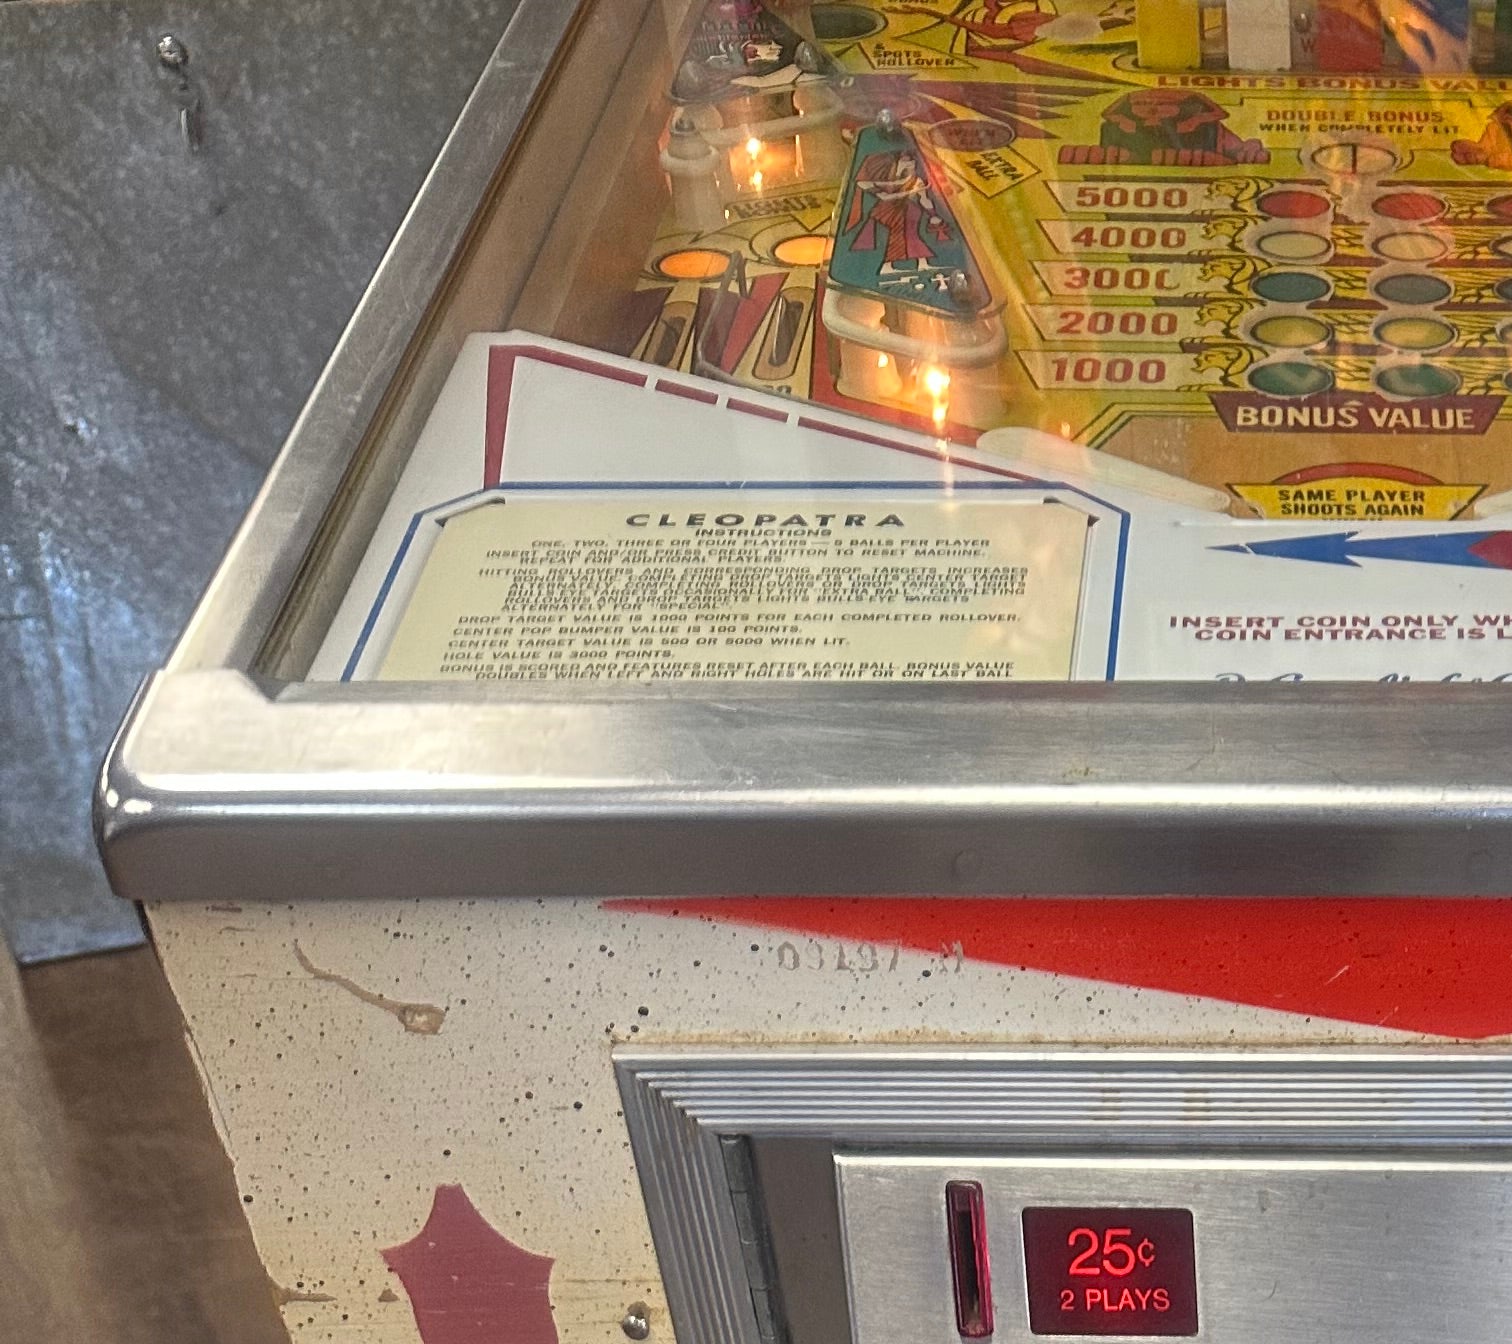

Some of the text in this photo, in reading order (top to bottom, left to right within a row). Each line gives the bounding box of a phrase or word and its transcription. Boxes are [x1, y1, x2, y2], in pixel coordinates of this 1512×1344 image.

[1156, 76, 1286, 87] LIGHTS
[1297, 78, 1420, 89] BONUS
[1267, 111, 1444, 123] DOUBLE BONUS
[1259, 123, 1311, 132] WHEN
[1076, 187, 1188, 207] 5000
[1071, 226, 1186, 248] 4000
[1063, 267, 1180, 290] 3000
[1056, 311, 1178, 335] 2000
[1051, 357, 1166, 384] 1000
[1236, 404, 1476, 430] BONUS VALUE
[1278, 490, 1425, 502] SAME PLAYER
[1281, 503, 1425, 517] SHOOTS AGAIN
[626, 513, 905, 527] CLEOPATRA
[695, 529, 832, 538] INSTRUCTIONS
[486, 550, 539, 558] INSERT
[545, 550, 581, 558] COIN
[588, 550, 648, 558] AND/OR
[707, 549, 760, 557] CREDIT
[768, 549, 828, 557] BUTTON
[458, 615, 501, 623] DROP
[508, 615, 567, 623] TARGET
[573, 615, 622, 623] VALUE
[629, 614, 643, 622] IS
[652, 614, 688, 622] 1000
[694, 614, 750, 622] POINTS
[757, 614, 787, 622] FOR
[794, 614, 834, 622] EACH
[841, 613, 932, 621] COMPLETED
[1169, 616, 1284, 627] INSERT
[1297, 616, 1371, 626] COIN
[1380, 615, 1459, 626] ONLY
[453, 627, 514, 635] CENTER
[521, 627, 553, 635] POP
[558, 626, 624, 634] BUMPER
[630, 626, 680, 634] VALUE
[686, 626, 700, 634] IS
[709, 625, 738, 633] 100
[1194, 629, 1272, 640] COIN
[1283, 629, 1446, 640] ENTRANCE
[1457, 628, 1486, 639] IS
[448, 640, 509, 648] CENTER
[516, 639, 576, 647] TARGET
[582, 639, 633, 647] VALUE
[639, 639, 653, 647] IS
[660, 638, 689, 646] 500
[695, 638, 719, 646] OR
[725, 638, 763, 646] 5000
[770, 637, 816, 645] WHEN
[443, 652, 486, 660] HOLE
[491, 651, 542, 659] VALUE
[548, 651, 564, 659] IS
[569, 651, 608, 659] 3000
[439, 664, 495, 672] BONUS
[500, 664, 514, 672] IS
[519, 664, 581, 672] SCORED
[585, 663, 618, 671] AND
[623, 663, 702, 671] FEATURES
[706, 662, 756, 670] RESET
[760, 662, 808, 670] AFTER
[813, 662, 854, 670] EACH
[906, 661, 961, 669] BONUS
[967, 661, 1013, 669] VALUE
[475, 672, 549, 680] DOUBLES
[555, 671, 602, 679] WHEN
[607, 671, 646, 679] LEFT
[650, 671, 686, 679] AND
[690, 671, 738, 679] RIGHT
[803, 670, 834, 678] ARE
[839, 670, 866, 678] HIT
[871, 670, 894, 678] OR
[1068, 1228, 1156, 1276] 25¢
[1060, 1288, 1170, 1311] 2 PLAYS
